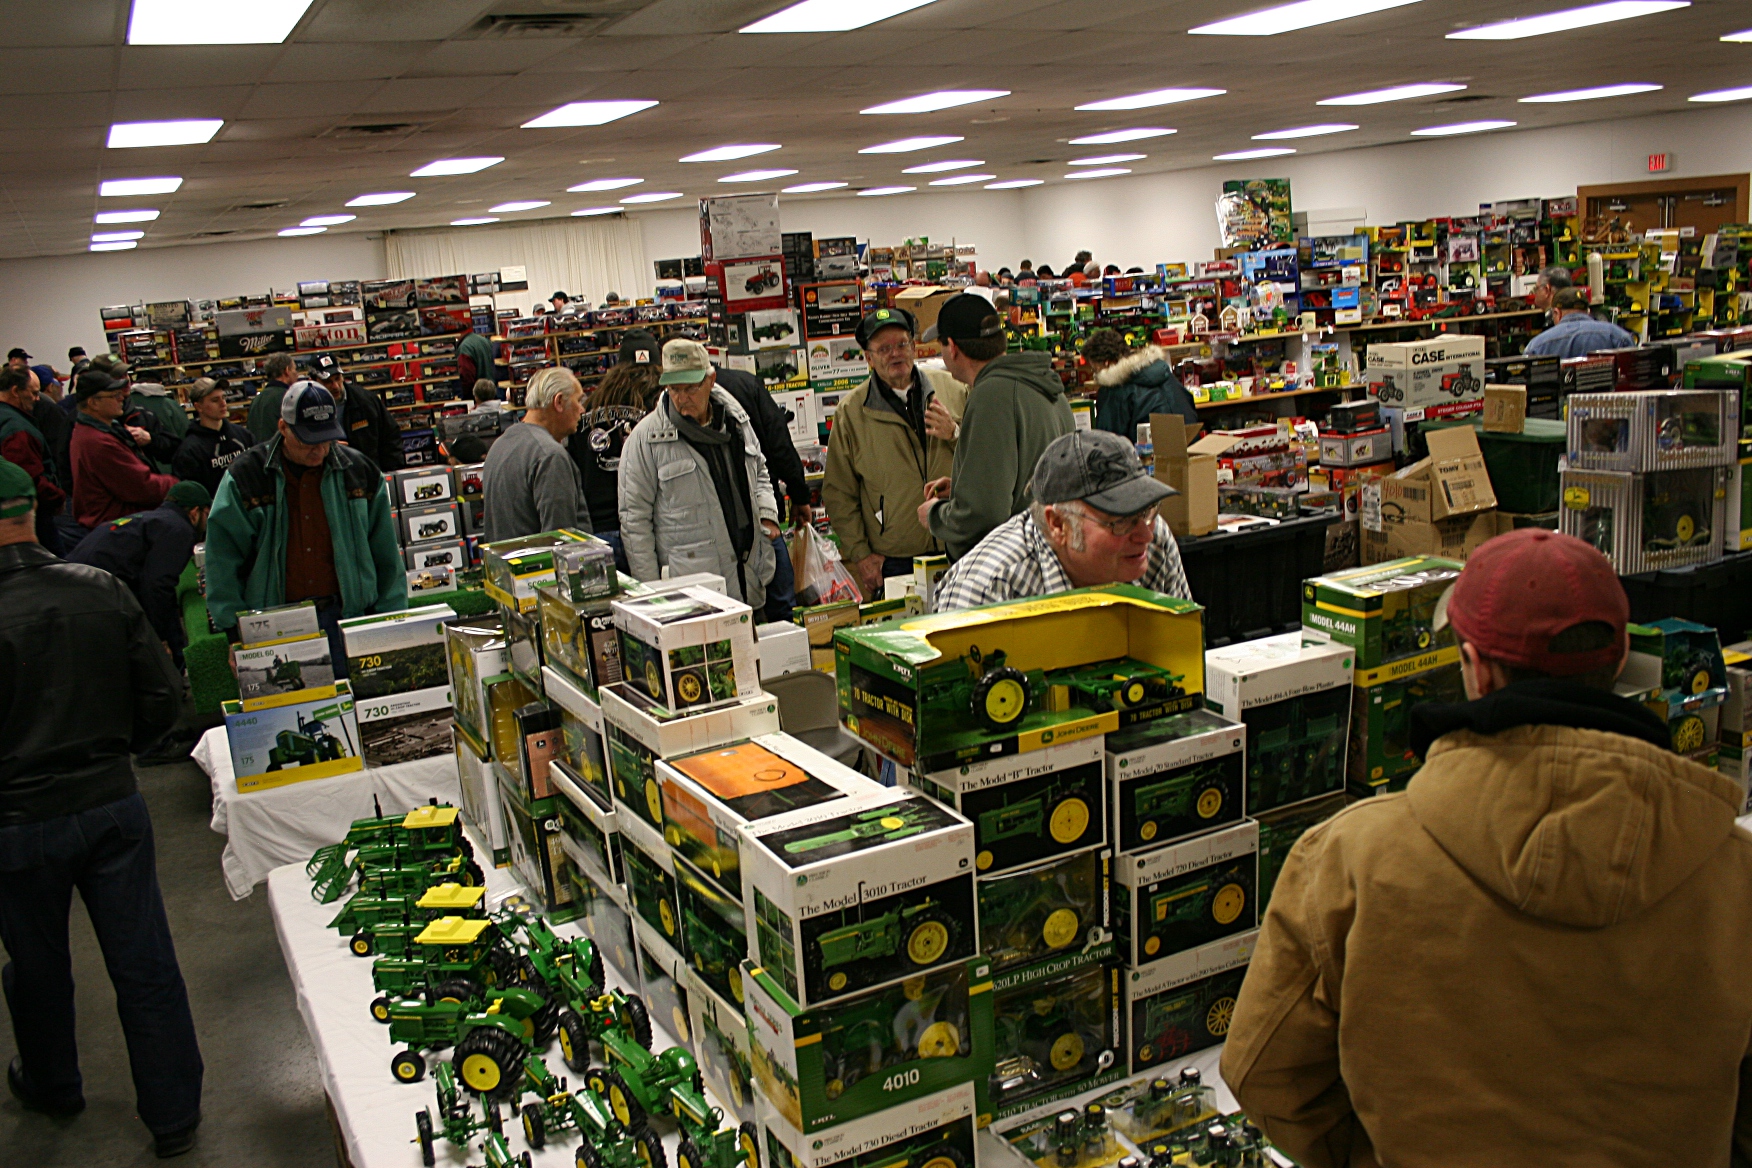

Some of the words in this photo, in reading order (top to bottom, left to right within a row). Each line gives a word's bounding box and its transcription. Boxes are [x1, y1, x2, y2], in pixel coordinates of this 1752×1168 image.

[1648, 154, 1666, 171] EXIT
[239, 334, 275, 352] Miller
[1412, 350, 1446, 365] CASE
[1446, 351, 1481, 360] INTERNATIONAL
[1438, 465, 1459, 474] TOMY
[249, 620, 270, 631] 175
[1310, 612, 1335, 630] MODEL
[1334, 620, 1356, 635] 44AH
[242, 652, 264, 660] MODEL
[264, 649, 275, 657] 60
[359, 655, 382, 669] 730
[893, 664, 912, 678] ERTL
[1391, 659, 1418, 677] MODEL
[1417, 654, 1438, 669] 44AH
[247, 682, 261, 692] 175
[861, 690, 884, 711] TRACTOR
[1242, 699, 1254, 708] The
[1254, 694, 1273, 705] Model
[364, 705, 389, 719] 730
[1139, 709, 1163, 721] TRACTOR
[1164, 705, 1179, 716] WITH
[1180, 701, 1193, 713] DISK
[1056, 728, 1076, 739] JOHN
[1075, 723, 1100, 734] DEERE
[241, 755, 255, 766] 175
[1120, 771, 1132, 780] The
[1132, 765, 1153, 777] Model
[1164, 756, 1192, 770] Standard
[1192, 752, 1214, 762] Tractor
[960, 780, 978, 792] The
[979, 773, 1007, 789] Model
[1025, 763, 1055, 777] Tractor
[1137, 876, 1152, 885] The
[1152, 867, 1174, 881] Model
[1176, 865, 1187, 875] 720
[1188, 857, 1209, 870] Diesel
[1210, 851, 1233, 864] Tractor
[798, 905, 820, 917] The
[823, 892, 858, 911] Model
[863, 885, 888, 900] 3010
[889, 875, 927, 893] Tractor
[1022, 966, 1046, 983] HIGH
[1046, 959, 1071, 975] CROP
[1072, 946, 1112, 967] TRACTOR
[1133, 990, 1144, 999] The
[1144, 984, 1161, 995] Model
[1167, 976, 1185, 987] Tractor
[1185, 973, 1198, 981] with
[883, 1068, 920, 1092] 4010
[1016, 1093, 1058, 1114] TRACTOR
[1088, 1072, 1120, 1089] MOWER
[813, 1155, 832, 1168] The
[834, 1145, 863, 1162] Model
[864, 1138, 879, 1151] 730
[880, 1128, 908, 1146] Diesel
[908, 1118, 940, 1135] Tractor
